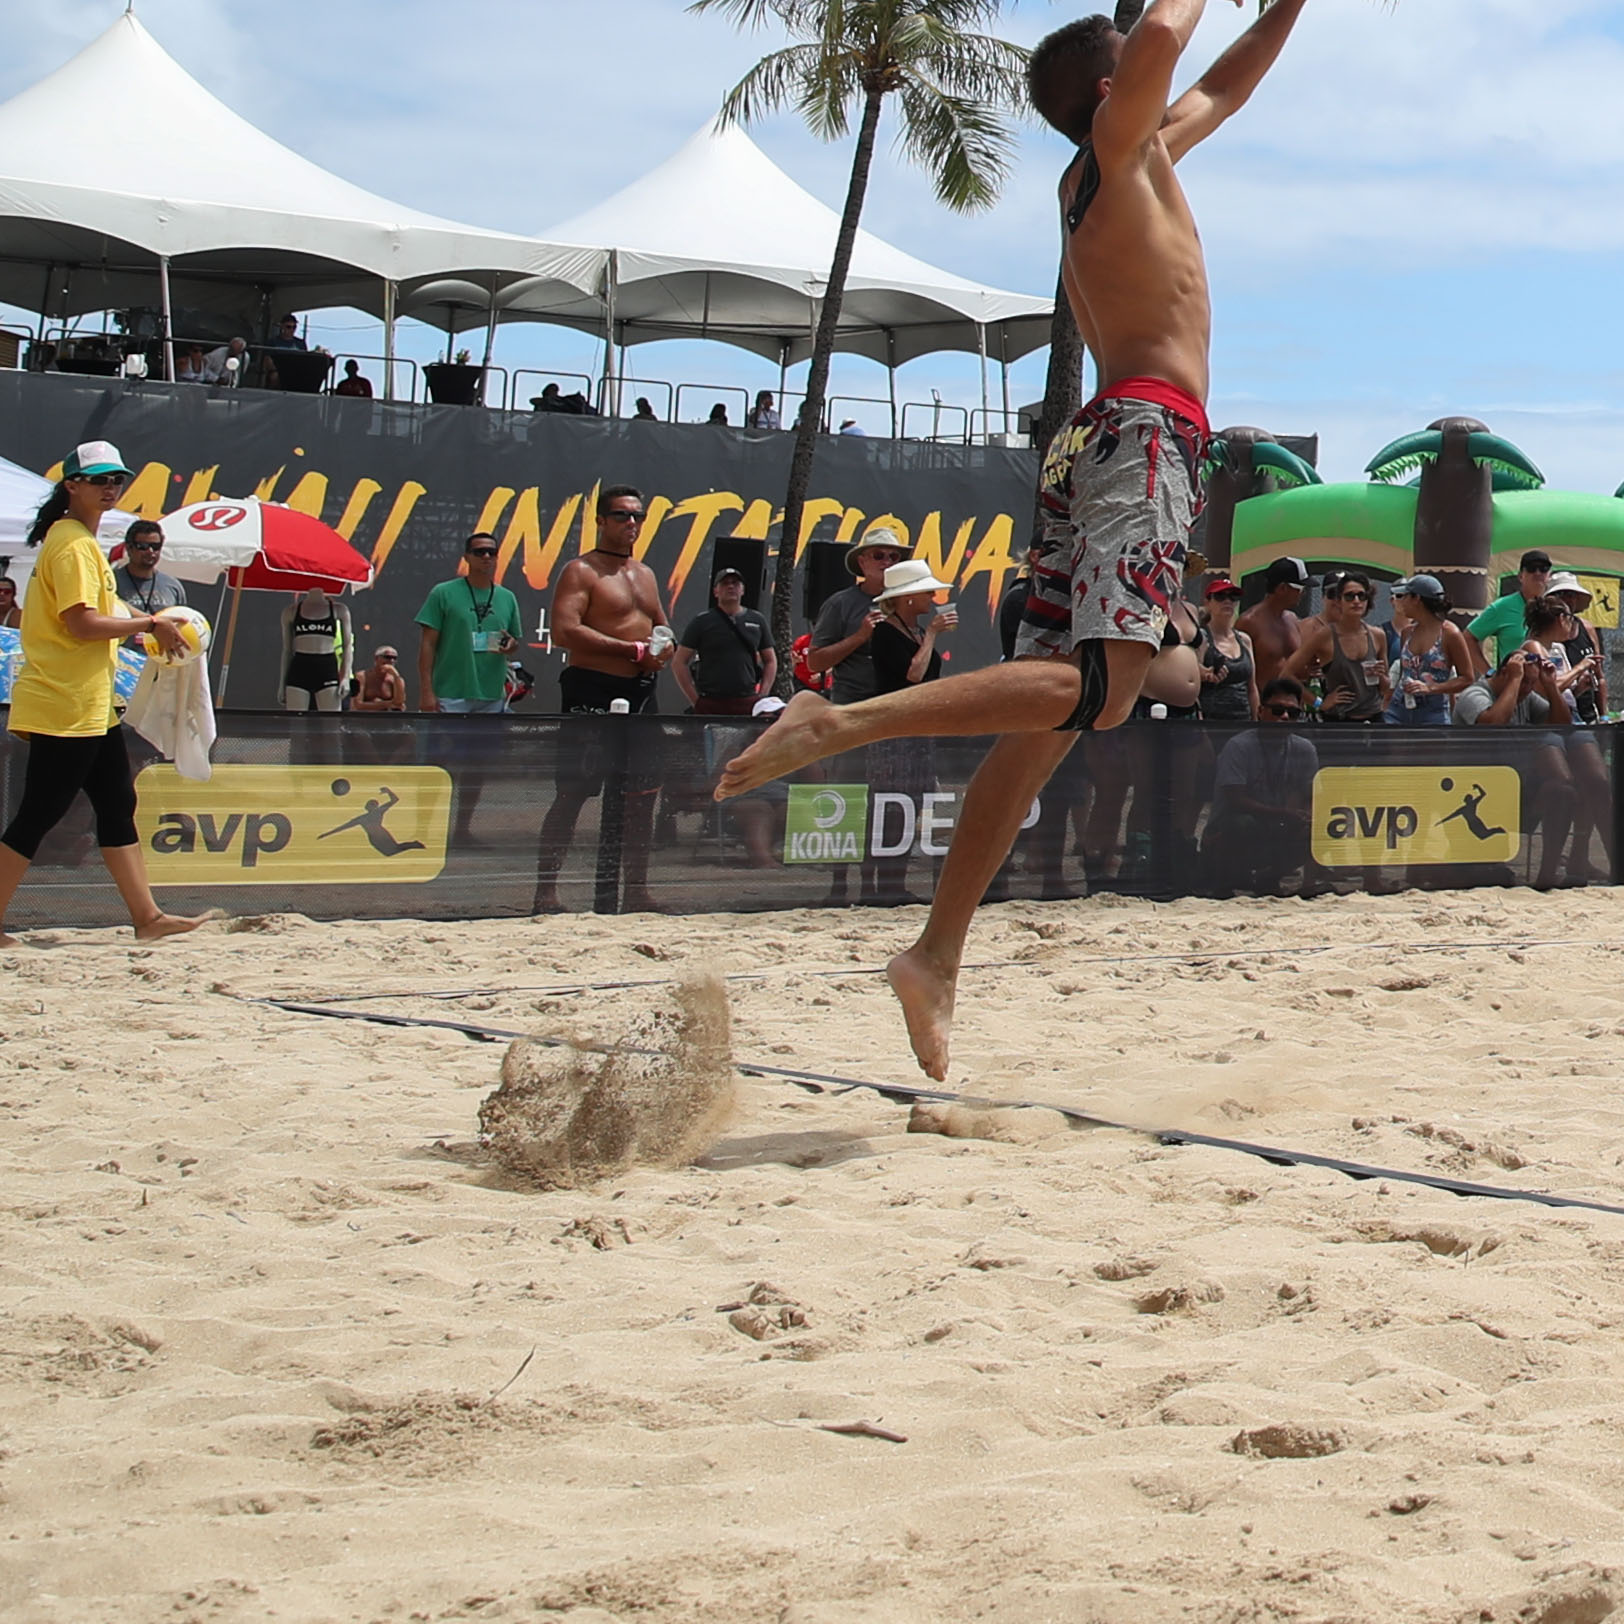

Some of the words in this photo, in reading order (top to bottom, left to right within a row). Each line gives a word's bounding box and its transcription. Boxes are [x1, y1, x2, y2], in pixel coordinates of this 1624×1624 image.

[296, 624, 332, 632] ALOHA
[151, 812, 292, 867] avp
[1326, 805, 1418, 849] avp
[791, 831, 858, 860] KONA
